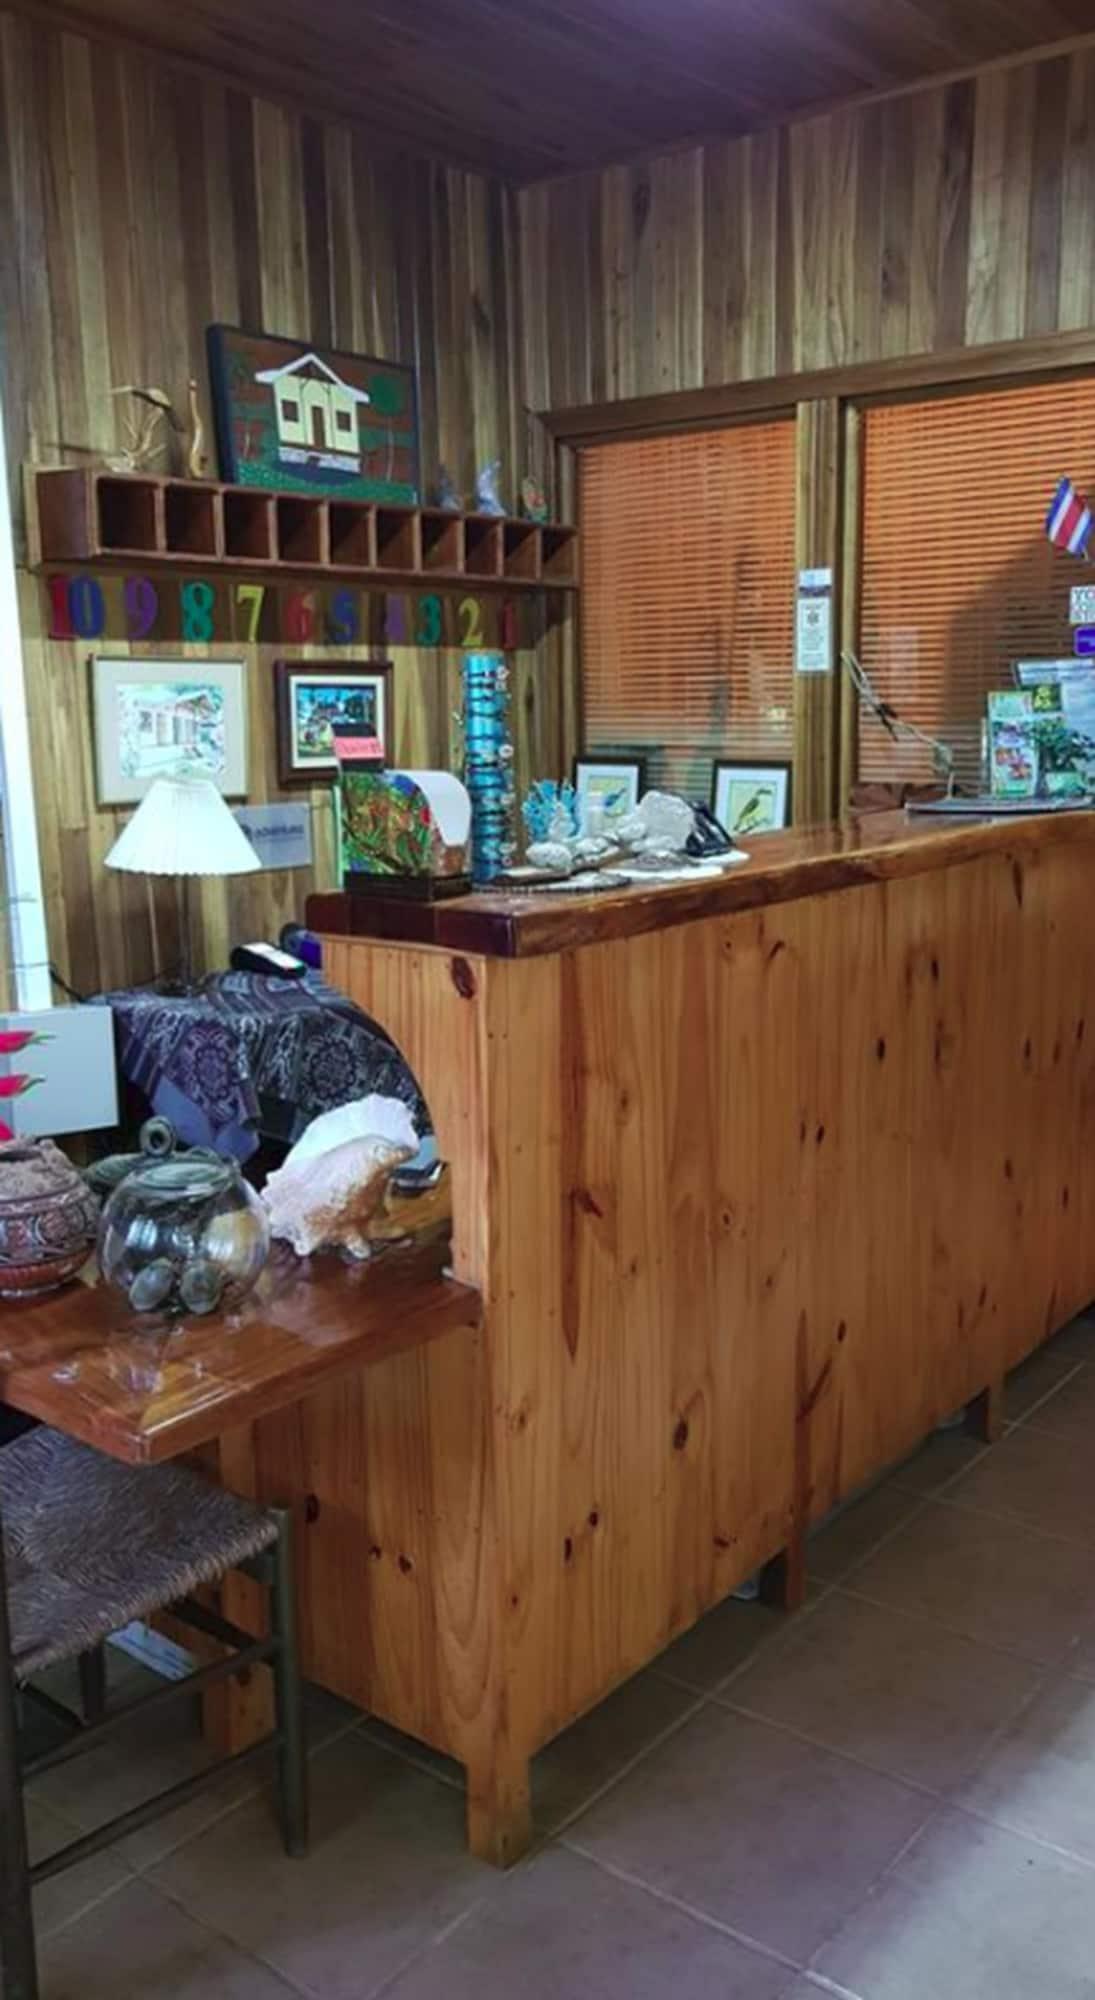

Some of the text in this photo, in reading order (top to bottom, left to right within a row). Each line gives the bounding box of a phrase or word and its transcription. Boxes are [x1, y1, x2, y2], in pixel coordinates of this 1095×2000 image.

[49, 574, 105, 640] 10
[124, 574, 159, 640] 9
[180, 580, 216, 642] 8
[235, 584, 265, 643] 7
[284, 592, 315, 645] 6
[328, 586, 359, 645] 5
[415, 593, 442, 647] 3
[458, 597, 484, 646] 2
[501, 599, 518, 649] 1
